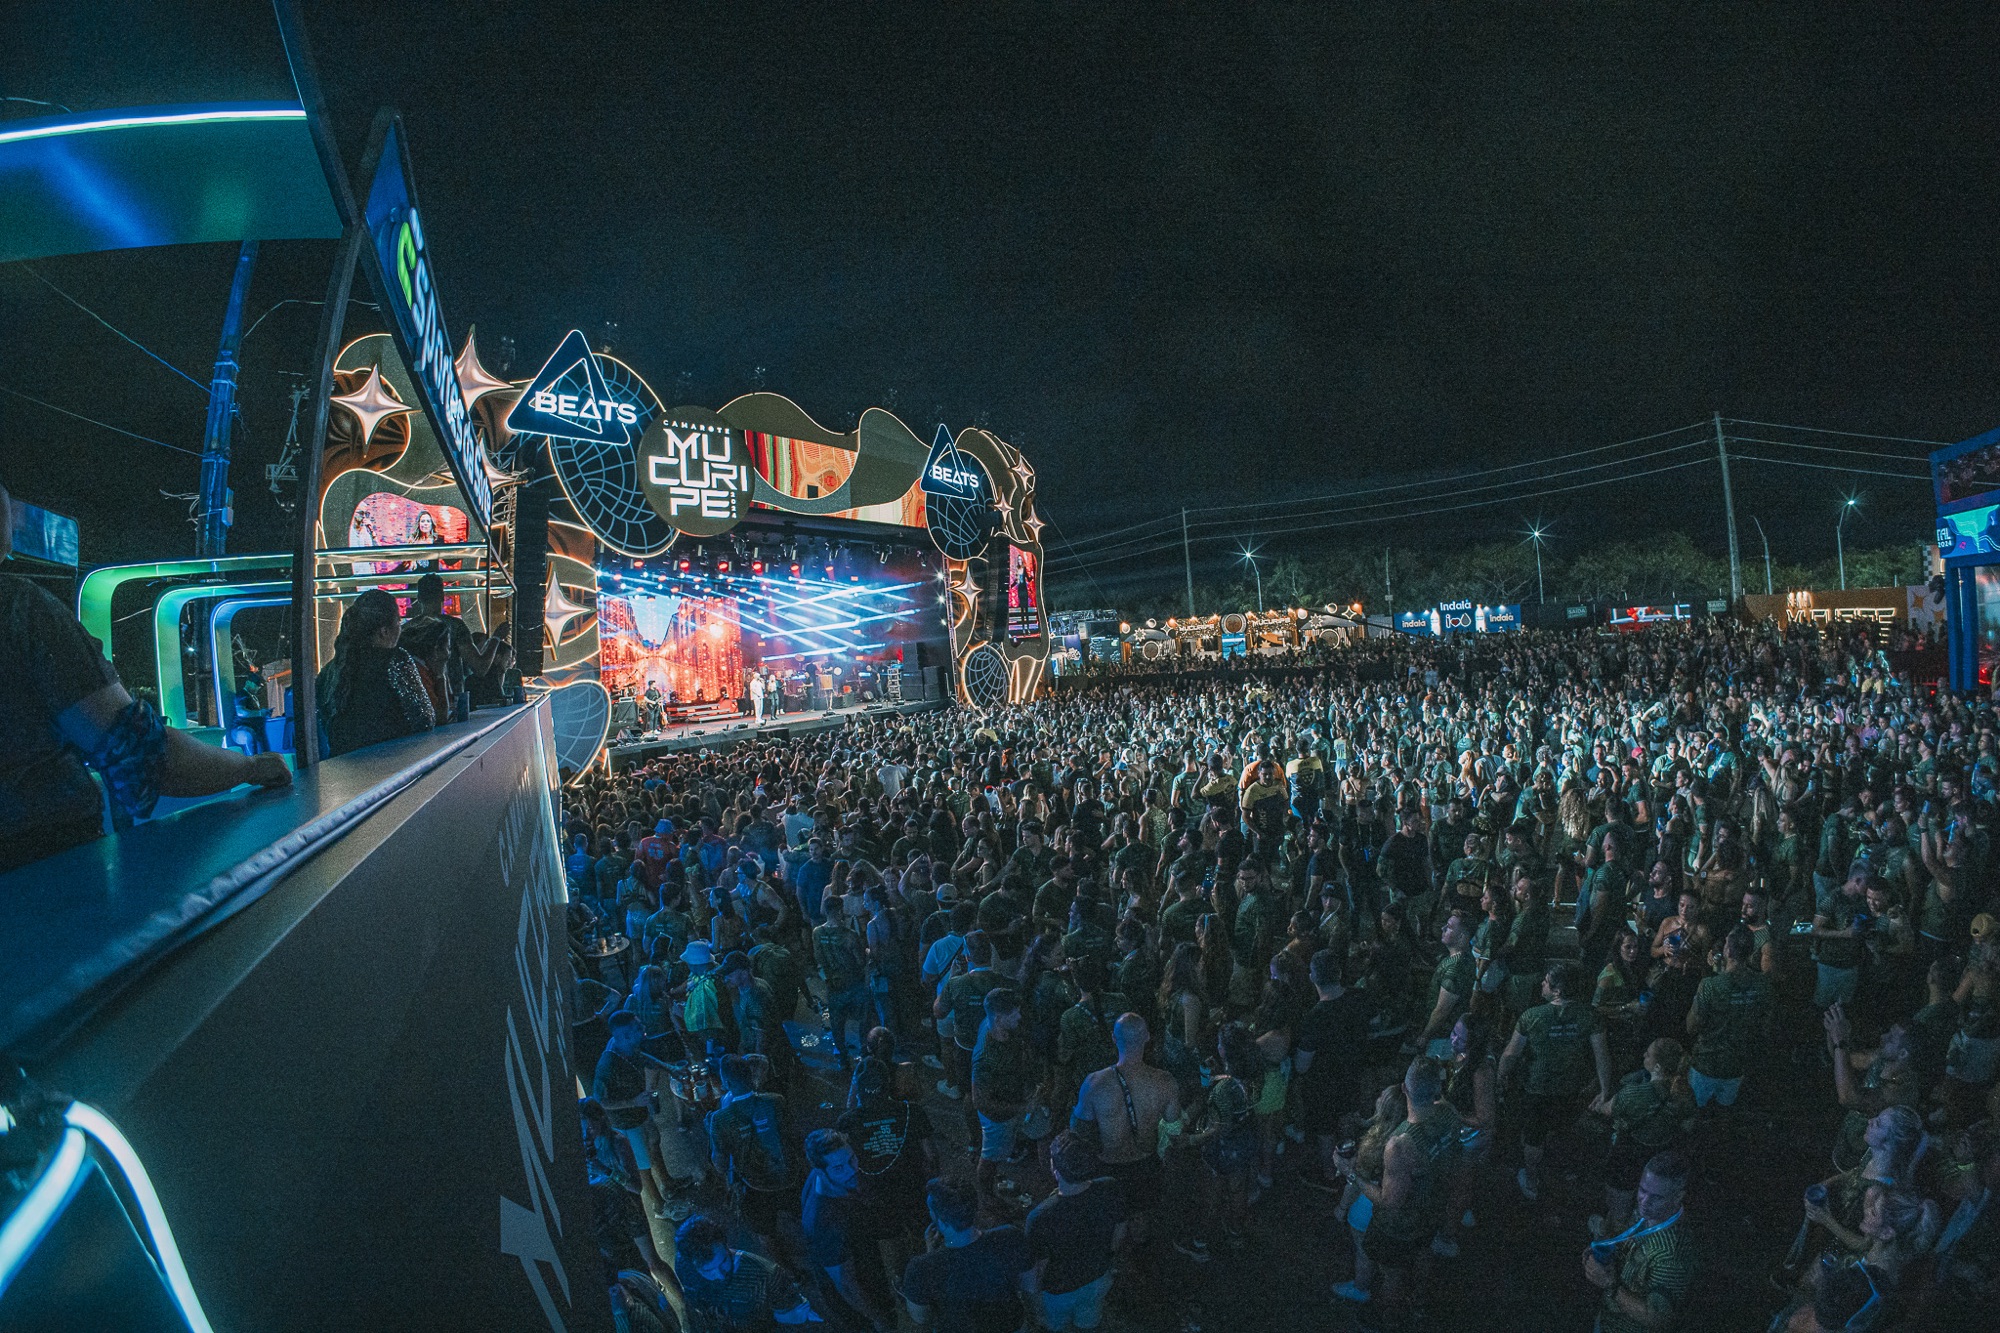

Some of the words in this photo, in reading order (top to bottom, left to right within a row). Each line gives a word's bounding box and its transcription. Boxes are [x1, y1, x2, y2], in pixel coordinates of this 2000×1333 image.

[535, 391, 638, 425] BEATS
[662, 419, 730, 435] CAMAROTE
[662, 428, 731, 463] MU
[931, 464, 979, 488] BEATS
[669, 486, 731, 519] PE
[1937, 540, 1952, 548] 2024
